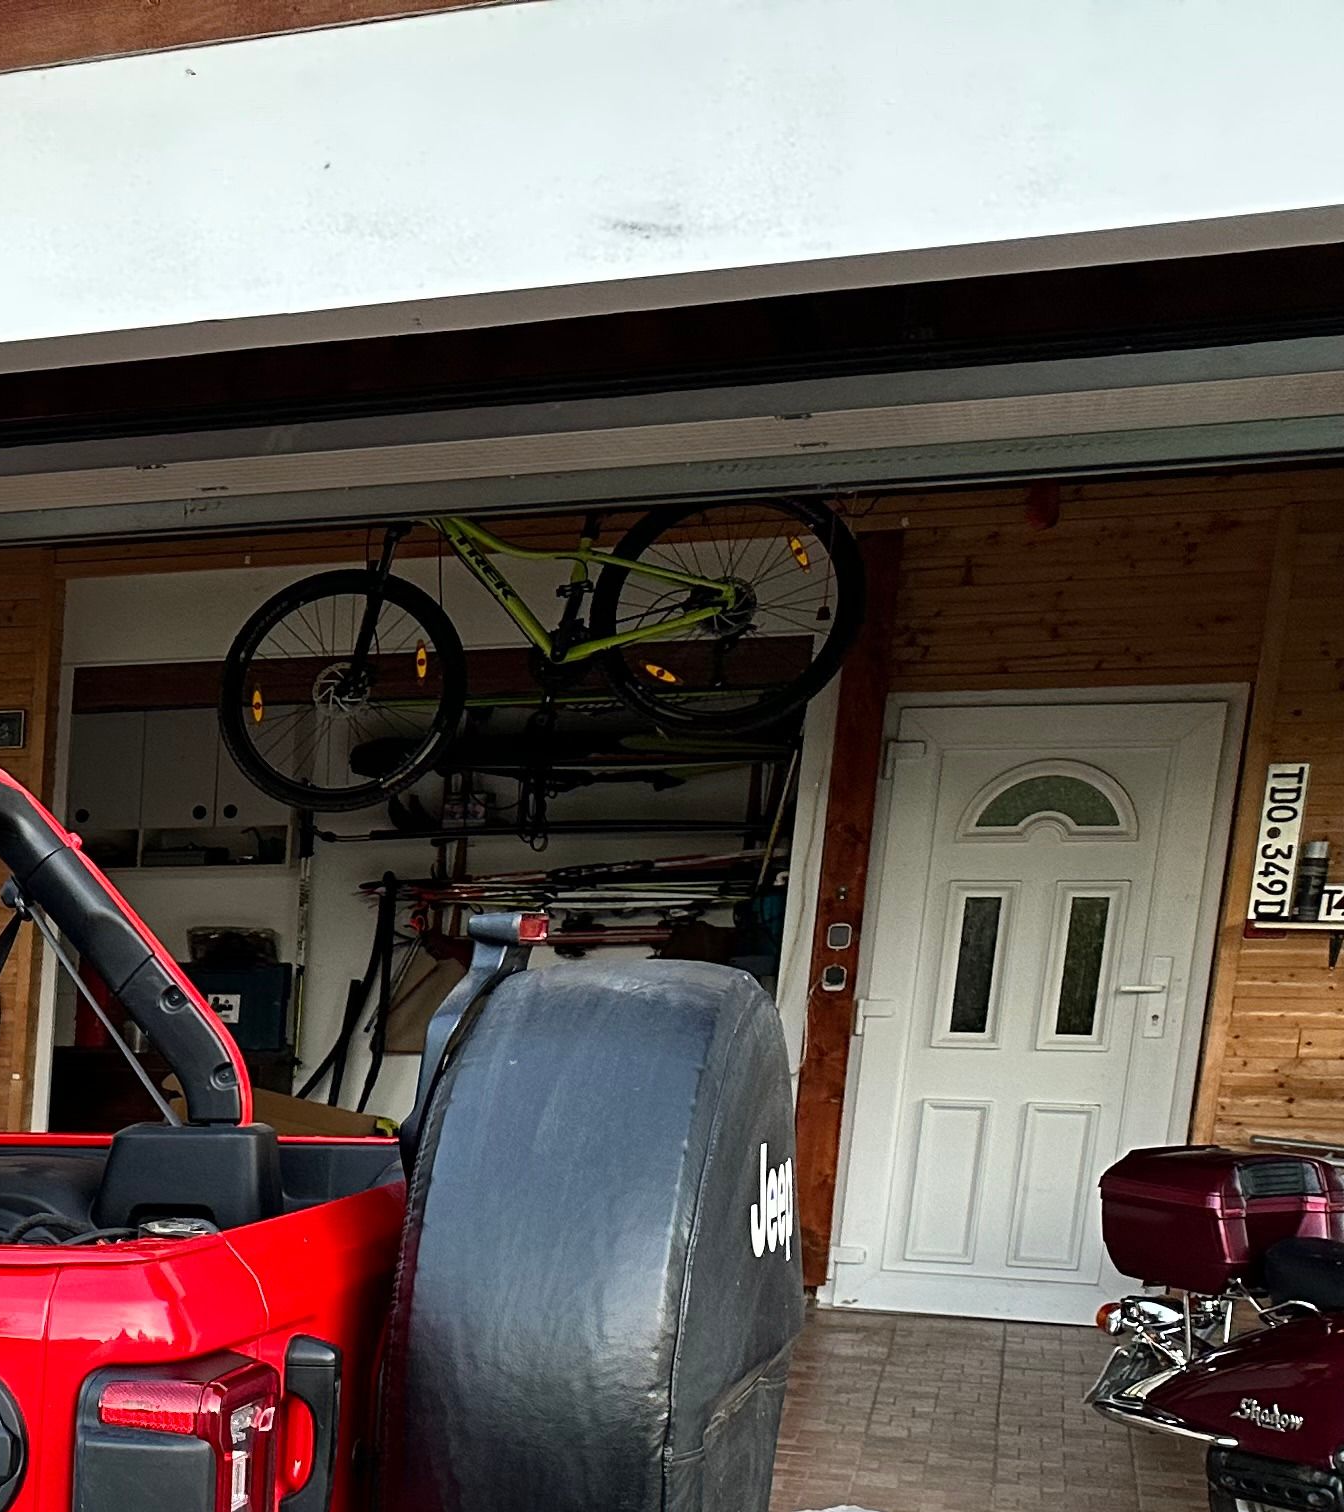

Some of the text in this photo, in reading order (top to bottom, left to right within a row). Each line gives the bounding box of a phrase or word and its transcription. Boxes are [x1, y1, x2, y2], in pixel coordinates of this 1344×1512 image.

[457, 530, 517, 600] TREK
[750, 1142, 793, 1261] Jeep
[1230, 1398, 1304, 1432] Shadow
